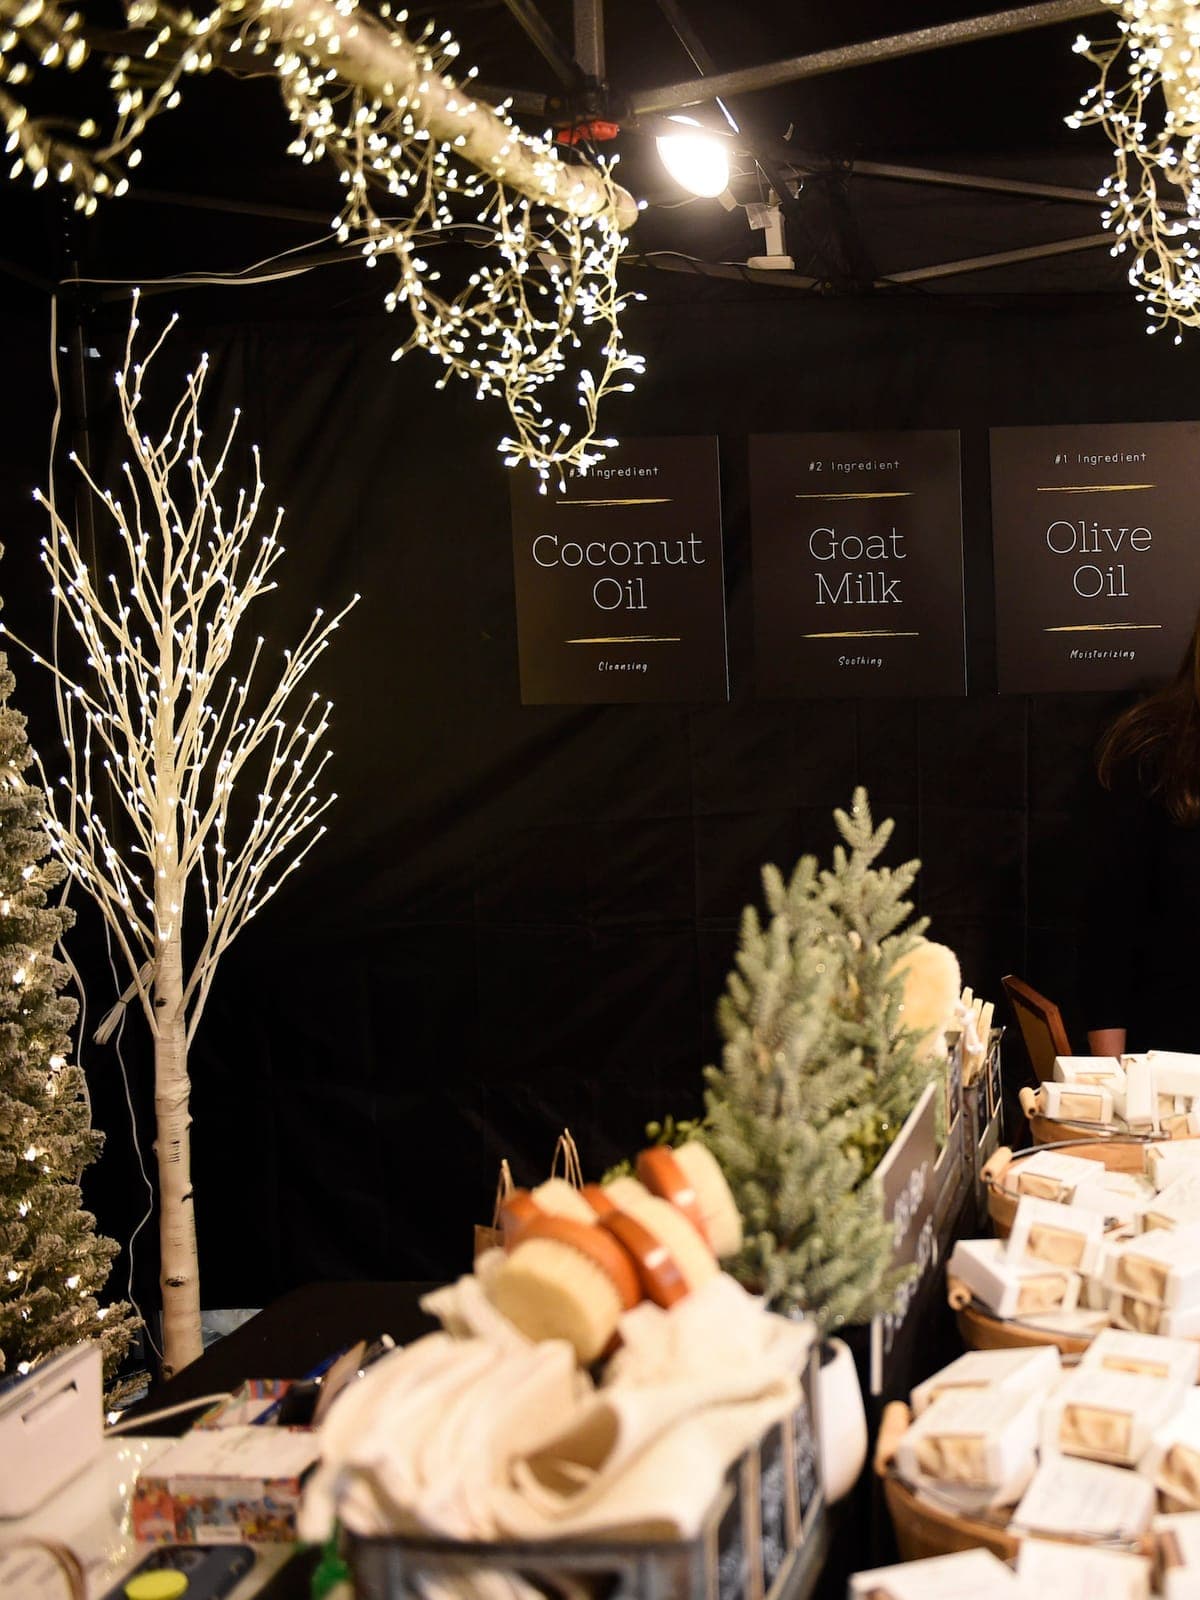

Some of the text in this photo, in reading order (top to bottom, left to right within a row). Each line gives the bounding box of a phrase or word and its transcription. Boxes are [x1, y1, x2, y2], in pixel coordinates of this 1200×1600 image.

[808, 460, 900, 473] #2 Ingredient
[1054, 452, 1148, 466] #1 Ingredient
[590, 466, 659, 480] Ingredient
[808, 526, 908, 561] Goat
[1046, 520, 1153, 555] Olive
[531, 532, 706, 568] Coconut
[814, 571, 903, 605] Milk
[1072, 564, 1129, 598] Oil
[592, 576, 648, 611] Oil
[598, 660, 648, 673] Cleansing
[838, 655, 884, 667] Soothing
[1069, 649, 1137, 661] Moisturizing
